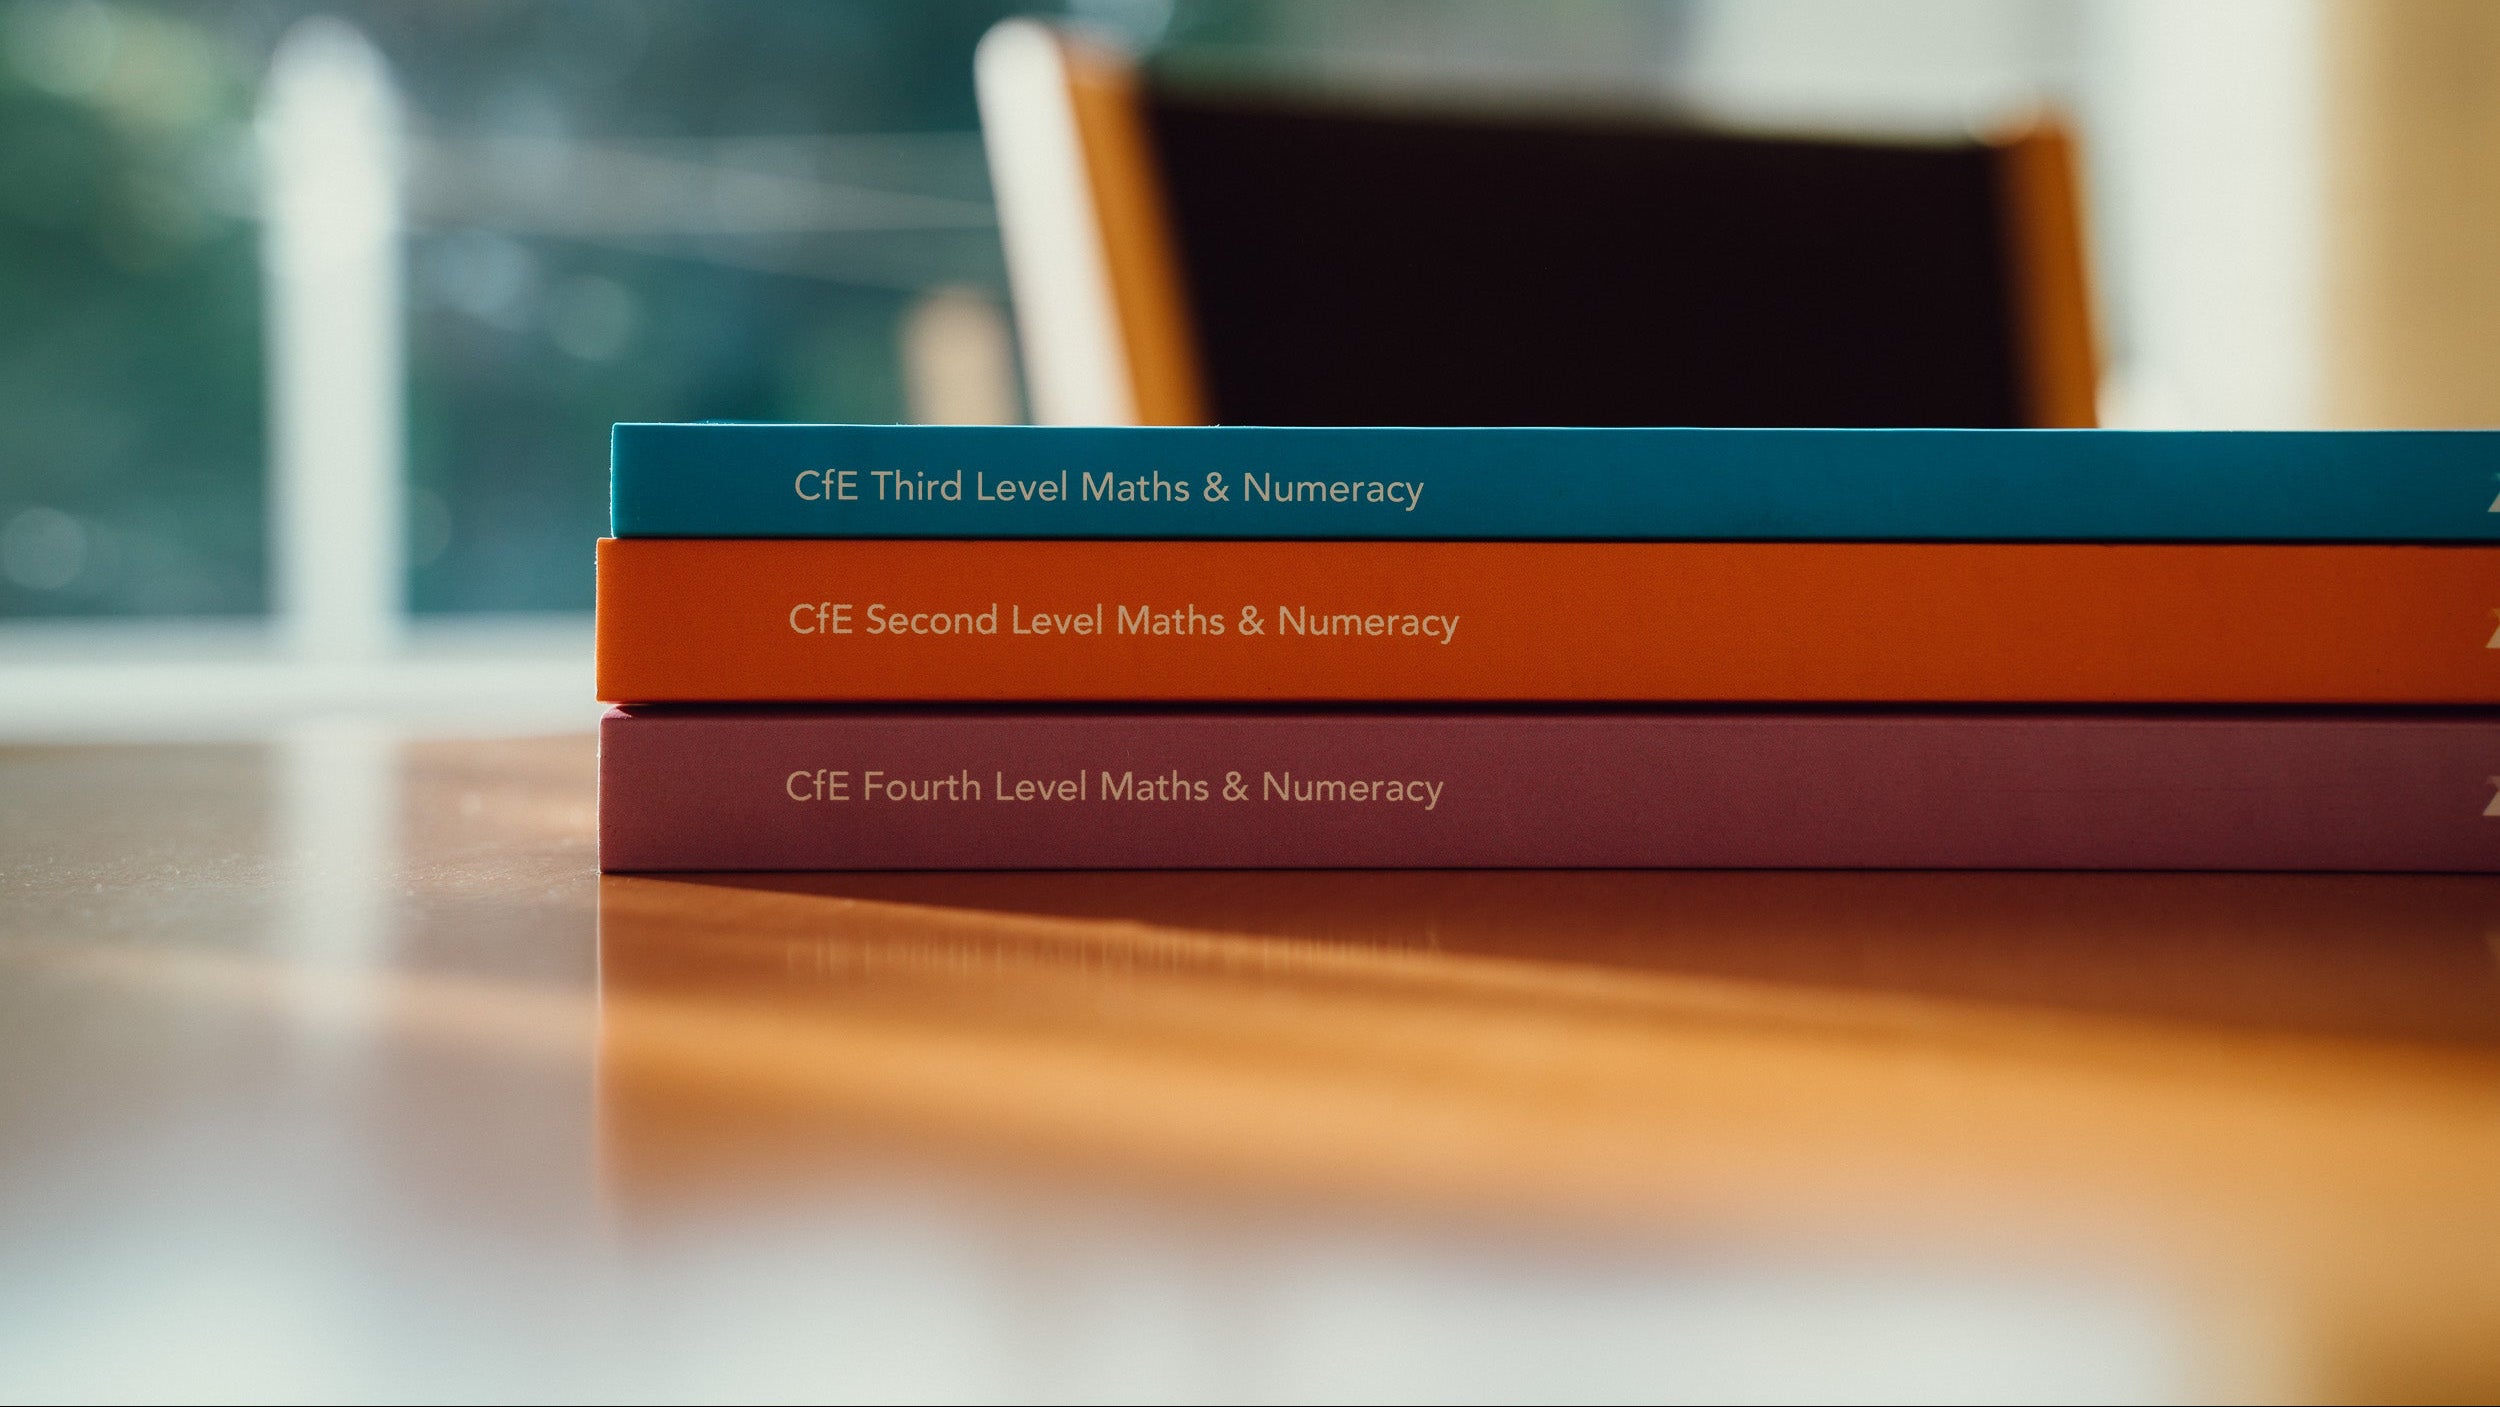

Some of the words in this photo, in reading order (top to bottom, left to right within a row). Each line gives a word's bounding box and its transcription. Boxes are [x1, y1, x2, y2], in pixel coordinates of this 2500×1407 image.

[795, 469, 859, 501] CfE
[871, 470, 962, 502] Third
[977, 470, 1067, 502] Level
[1083, 471, 1190, 502] Maths
[1204, 472, 1230, 503] &
[1244, 473, 1425, 512] Numeracy
[789, 602, 853, 635] CfE
[867, 603, 998, 635] Second
[1012, 604, 1103, 635] Level
[1118, 604, 1226, 636] Maths
[1239, 606, 1265, 636] &
[1279, 606, 1460, 645] Numeracy
[786, 769, 850, 802] CfE
[865, 770, 981, 801] Fourth
[996, 770, 1086, 802] Level
[1101, 770, 1209, 802] Maths
[1223, 771, 1250, 802] &
[1263, 772, 1444, 811] Numeracy
